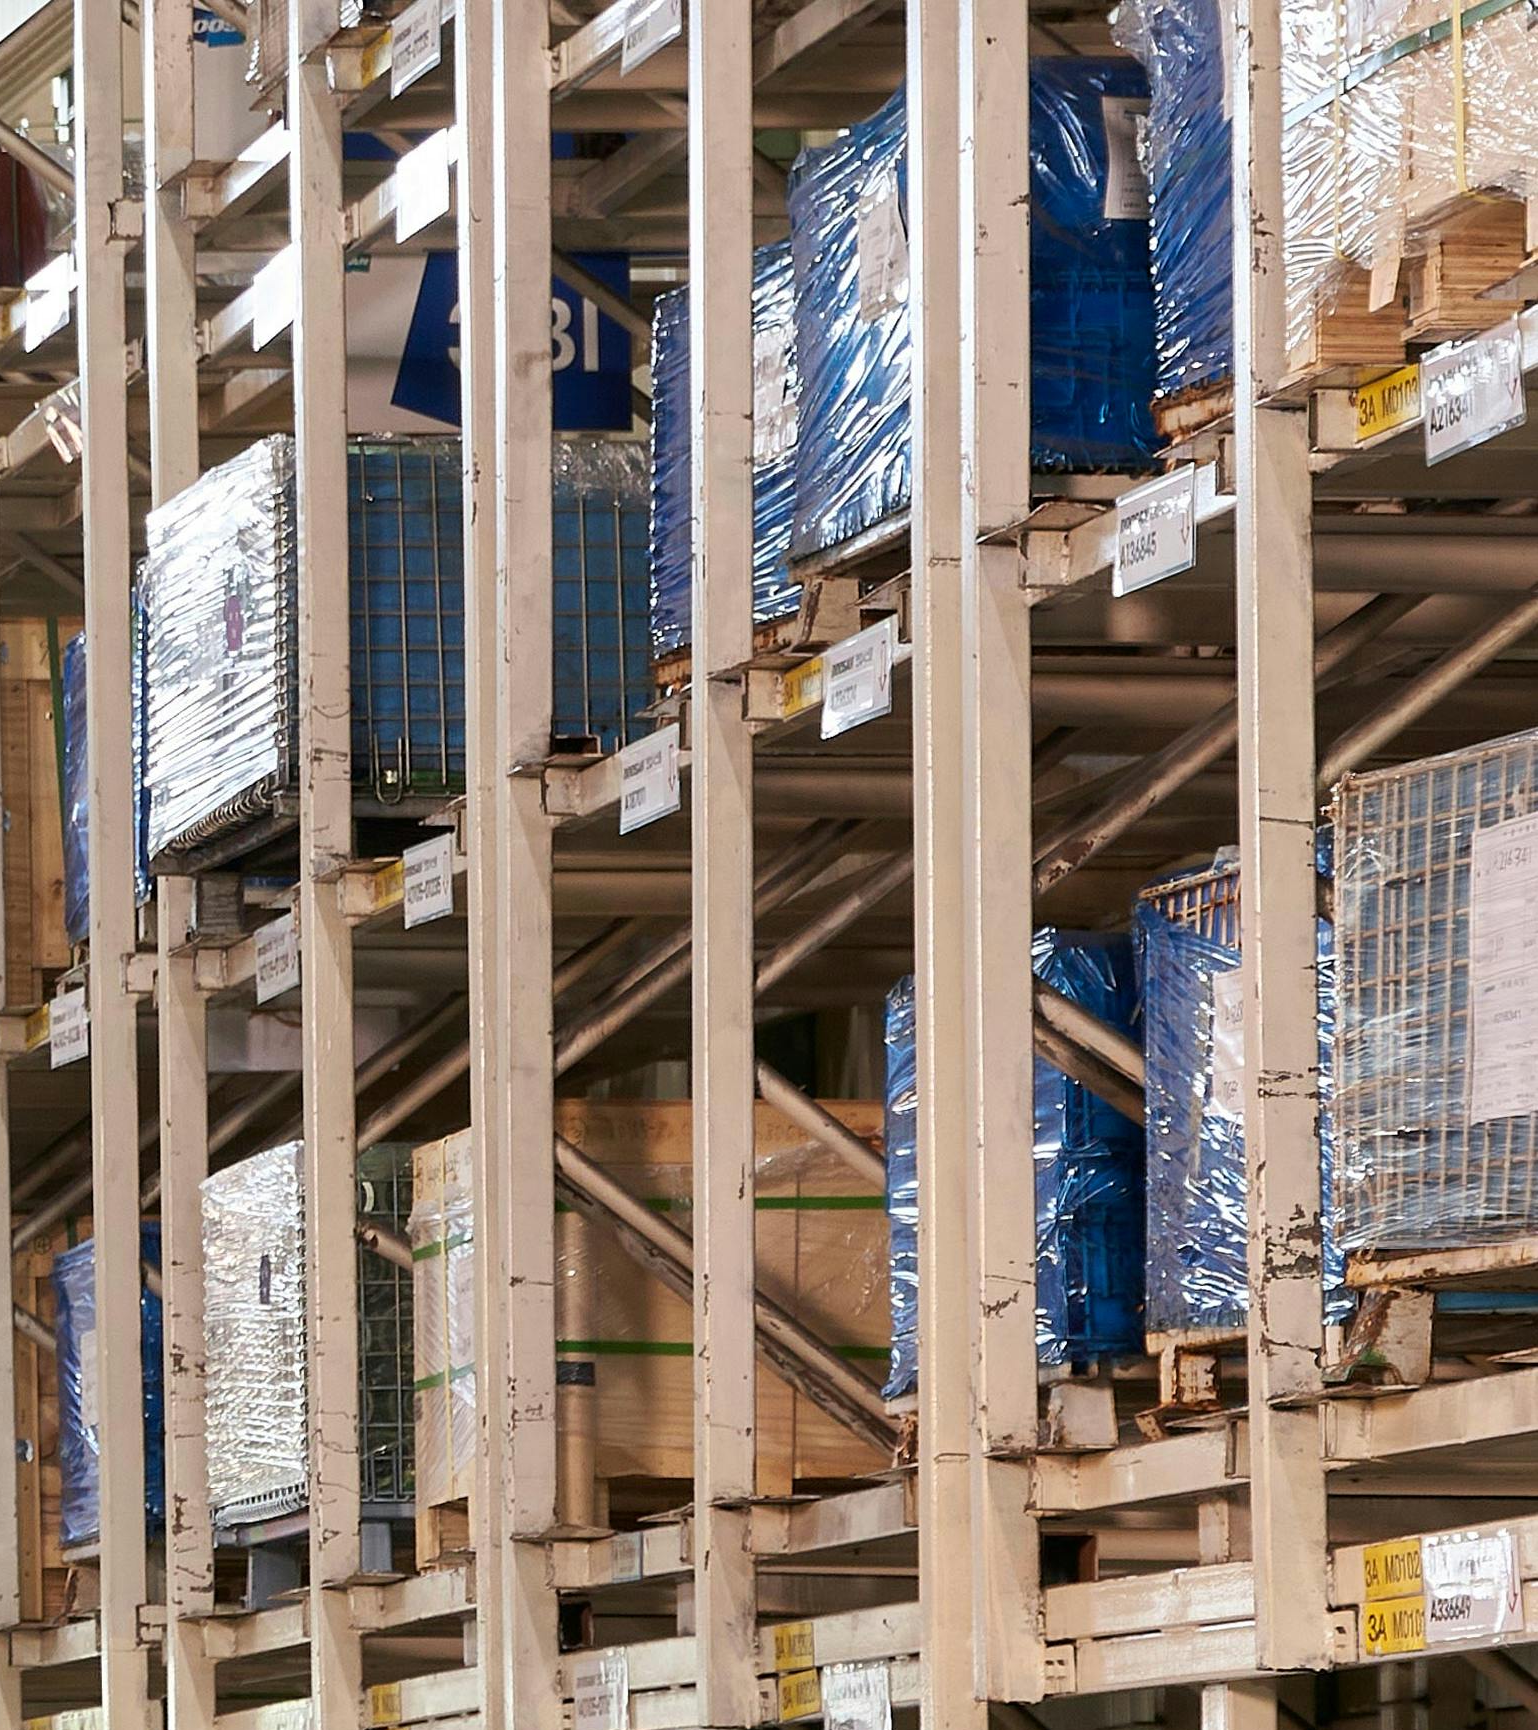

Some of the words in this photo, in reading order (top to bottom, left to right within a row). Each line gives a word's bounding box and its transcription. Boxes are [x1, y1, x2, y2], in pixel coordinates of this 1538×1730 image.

[1359, 397, 1377, 427] 3A
[1382, 379, 1419, 417] M0103
[1365, 1560, 1380, 1588] 3A
[1385, 1551, 1421, 1581] M0102
[1368, 1614, 1388, 1642] 3A
